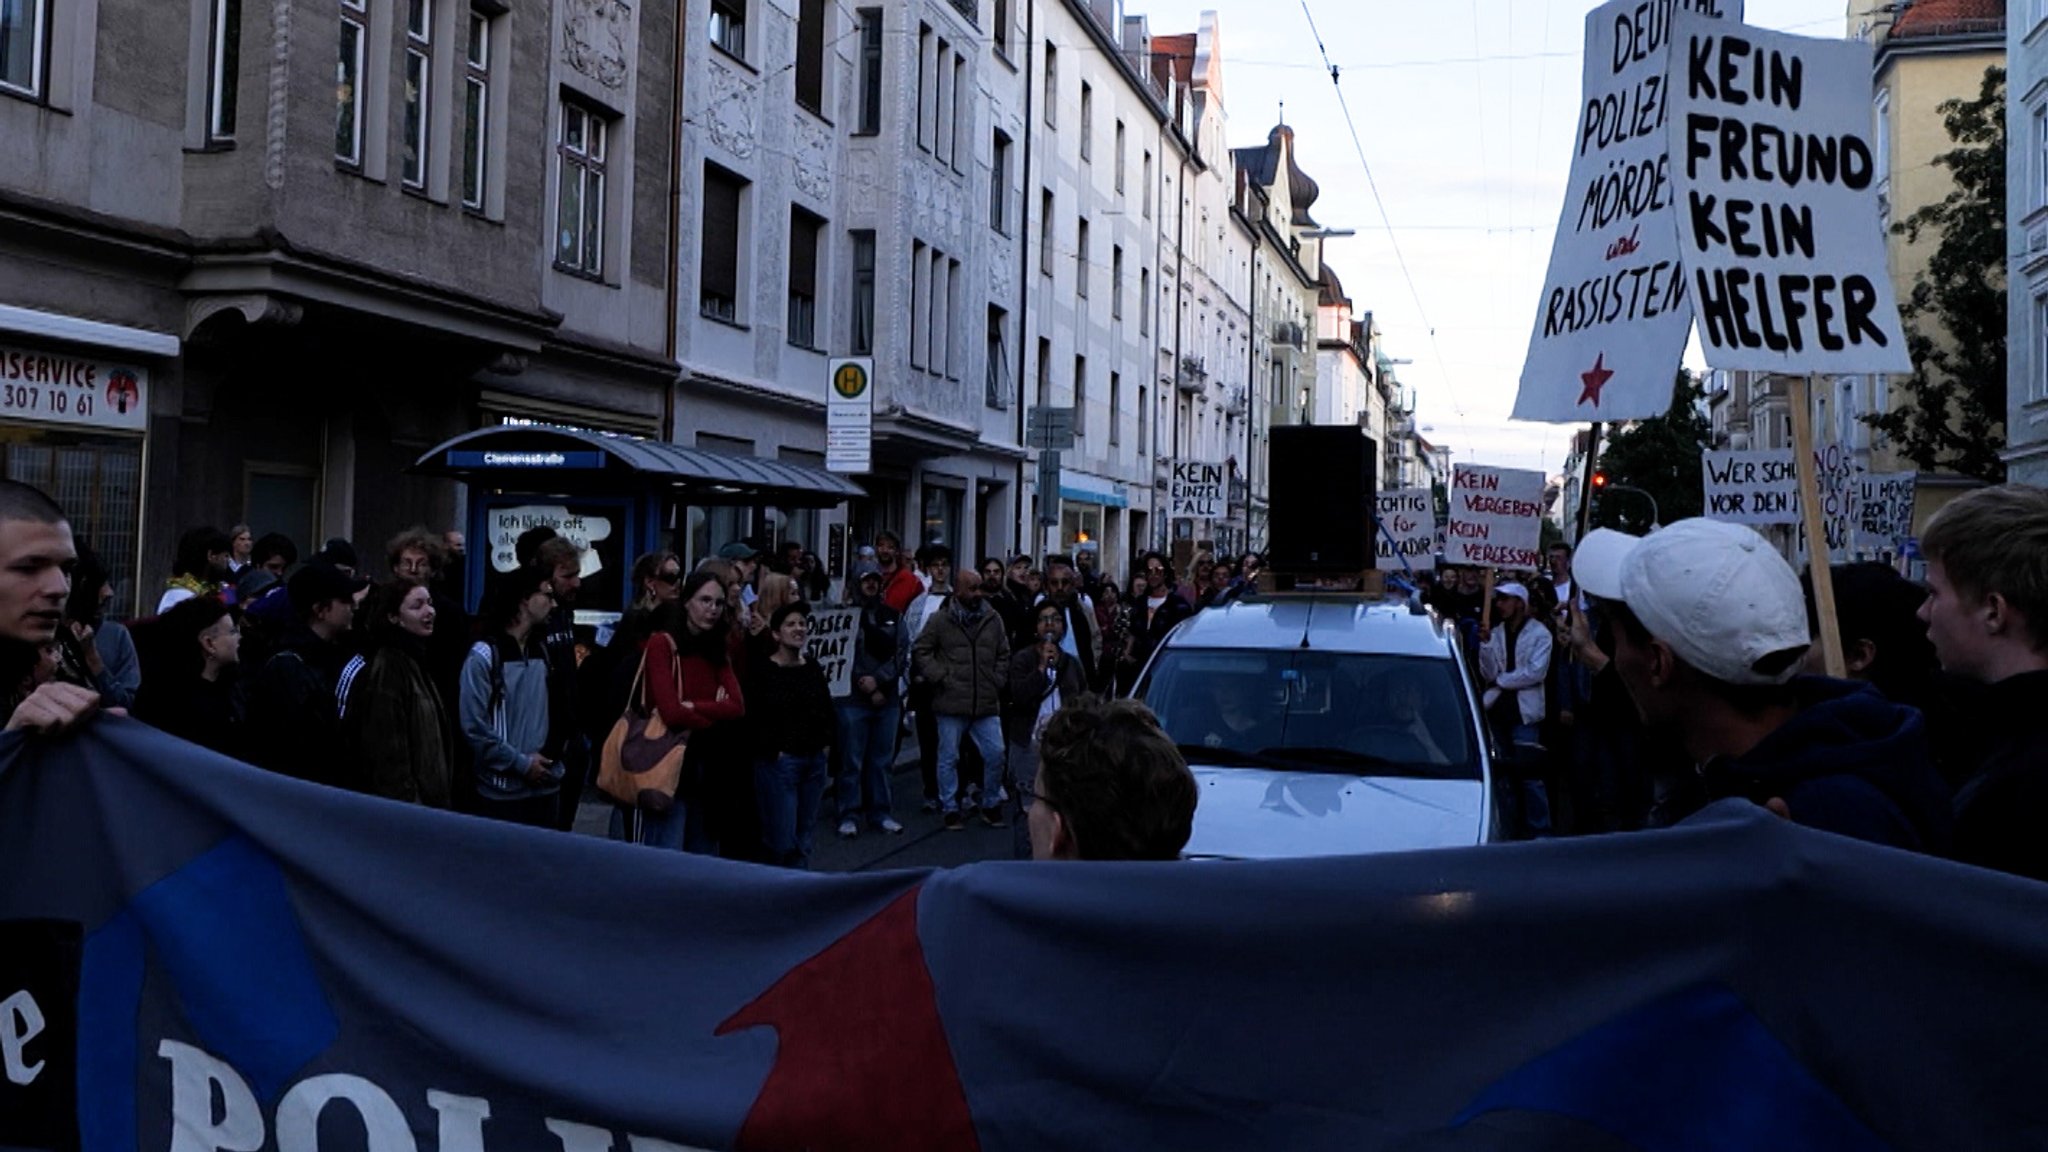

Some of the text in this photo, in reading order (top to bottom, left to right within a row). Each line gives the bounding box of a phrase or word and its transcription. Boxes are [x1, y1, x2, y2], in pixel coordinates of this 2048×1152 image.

[1689, 35, 1802, 110] KEIN
[1687, 113, 1873, 189] FREUND
[1576, 154, 1673, 232] MÖRDE
[1689, 190, 1815, 259] KEIN
[1605, 223, 1640, 260] und
[1544, 261, 1686, 338] RASSISTEN
[1696, 267, 1888, 351] HELFER
[4, 384, 93, 416] 307 10 61
[1173, 462, 1222, 483] KEIN
[1454, 469, 1499, 490] KEIN
[1707, 457, 1756, 484] WER
[1172, 482, 1222, 501] EINZEL
[1710, 494, 1745, 514] VOR
[1753, 492, 1787, 514] DEN
[1173, 500, 1216, 515] FALL
[1464, 494, 1541, 517] VERGEBEN
[498, 514, 519, 529] Ich
[1450, 518, 1489, 540] KEIN
[498, 551, 513, 563] es
[1463, 543, 1540, 566] VERGESSEN
[807, 614, 853, 636] DIESER
[808, 636, 849, 658] STAAT
